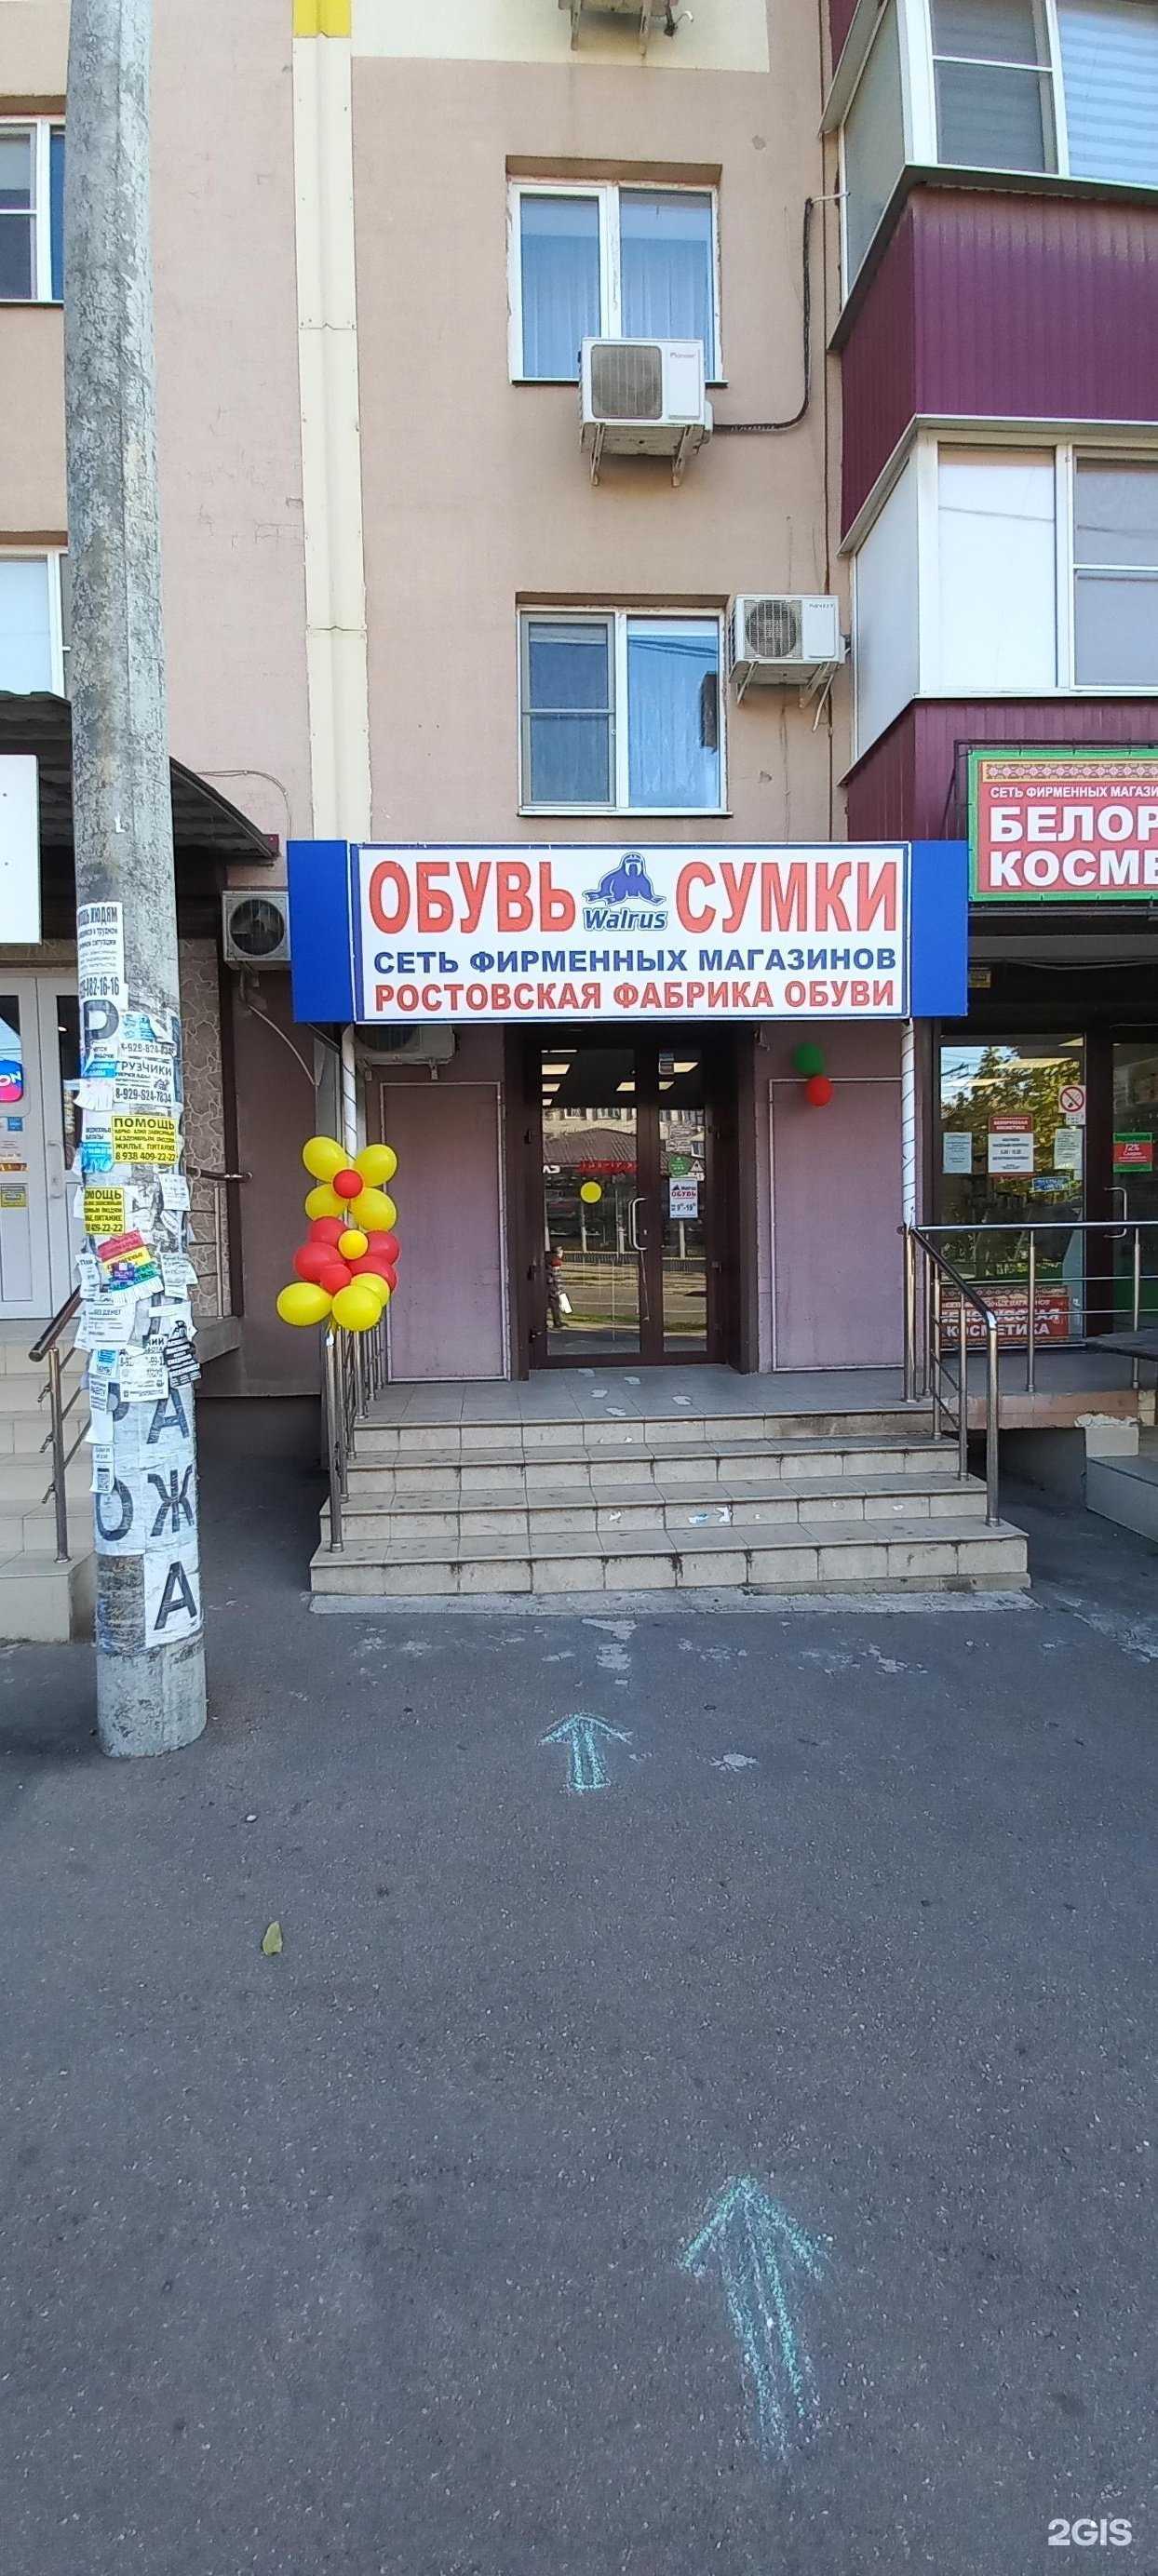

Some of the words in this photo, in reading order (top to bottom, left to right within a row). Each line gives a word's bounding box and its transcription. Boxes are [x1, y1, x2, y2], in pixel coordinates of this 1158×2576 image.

[990, 787, 1023, 798] СЕТЬ
[1027, 786, 1108, 798] ФИРМЕННЫХ
[990, 806, 1158, 842] БЕЛОР
[369, 861, 576, 933] ОБУВЬ
[676, 861, 897, 933] СУМКИ
[583, 907, 667, 932] Walrus
[373, 950, 460, 974] СЕТЬ
[469, 949, 687, 973] ФИРМЕННЫХ
[699, 947, 896, 972] МАГАЗИНОВ
[375, 982, 601, 1013] РОСТОВСКАЯ
[613, 981, 774, 1009] ФАБРИКА
[784, 980, 895, 1008] ОБУВИ
[114, 1118, 175, 1131] ПОМОЩЬ
